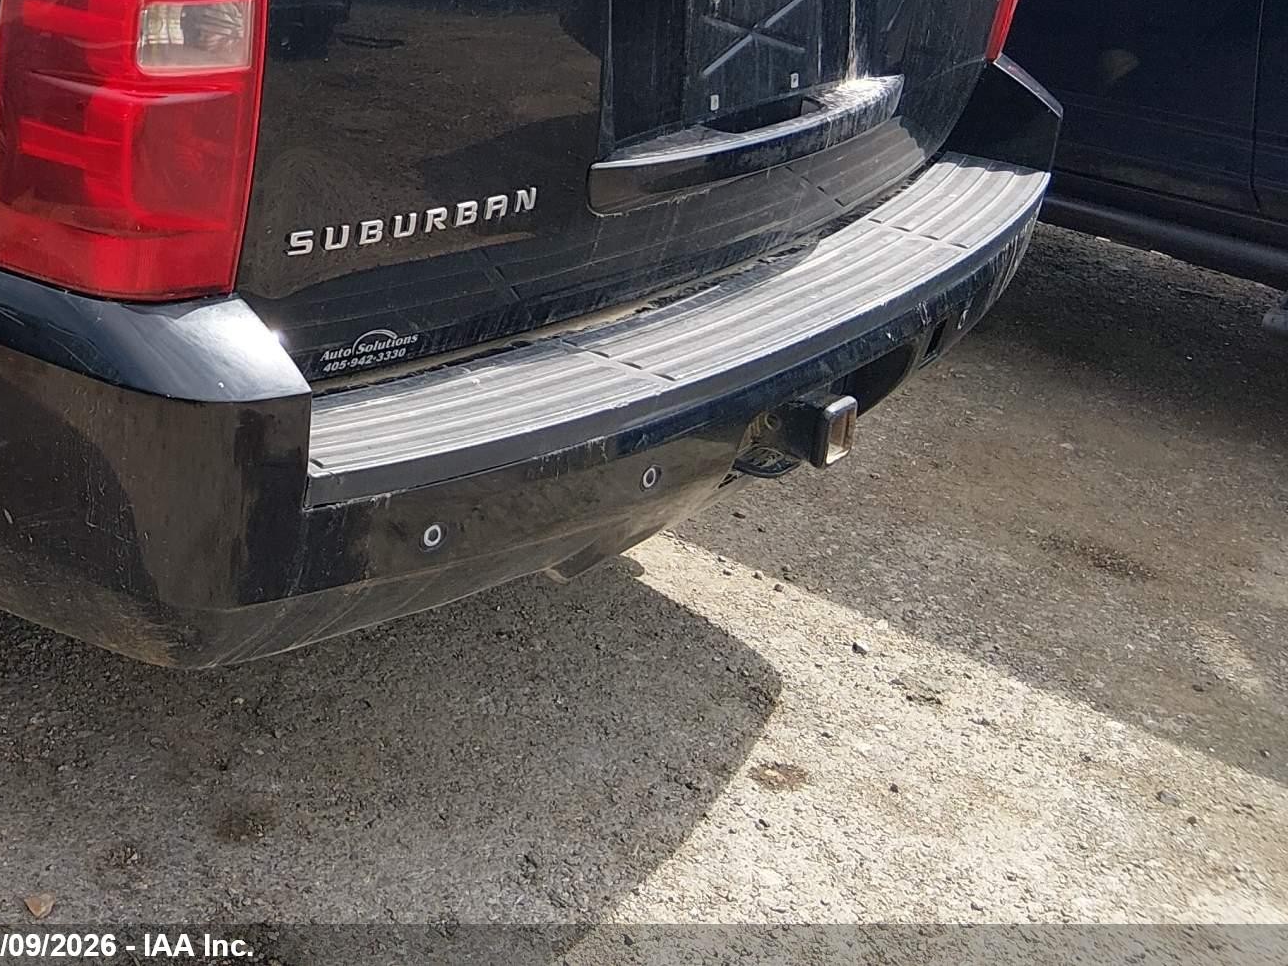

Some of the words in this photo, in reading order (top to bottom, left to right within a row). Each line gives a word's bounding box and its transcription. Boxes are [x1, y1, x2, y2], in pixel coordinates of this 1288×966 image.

[287, 187, 537, 256] SUBURBAN
[319, 348, 352, 361] Auto
[355, 334, 419, 355] Solutions
